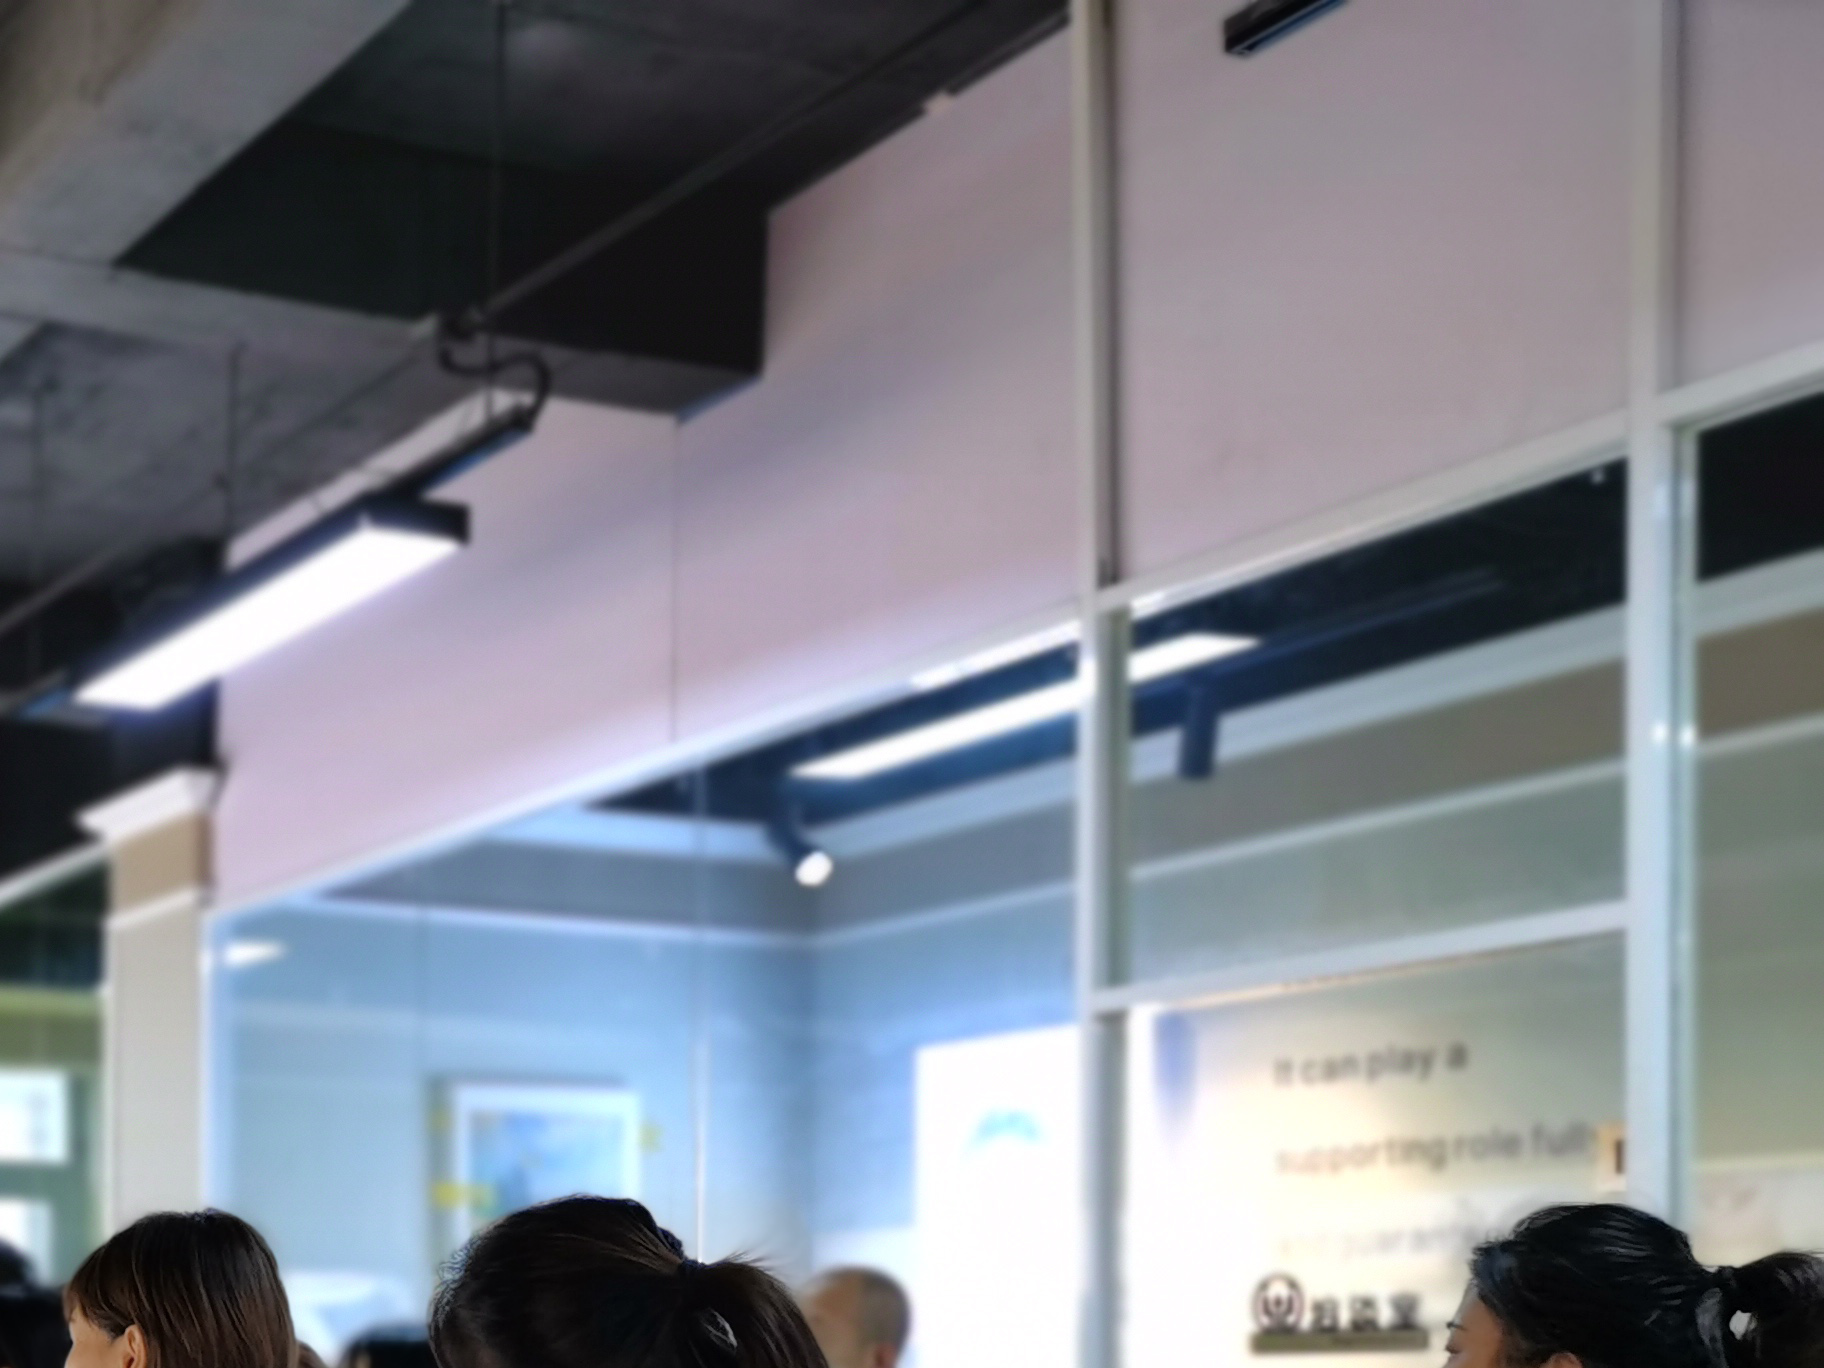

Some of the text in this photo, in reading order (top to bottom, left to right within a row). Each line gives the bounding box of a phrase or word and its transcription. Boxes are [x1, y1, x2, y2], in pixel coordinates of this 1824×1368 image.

[1300, 1051, 1360, 1086] can
[1365, 1042, 1440, 1083] play
[1446, 1040, 1470, 1072] a
[1276, 1134, 1448, 1177] supporting
[1453, 1126, 1524, 1164] role
